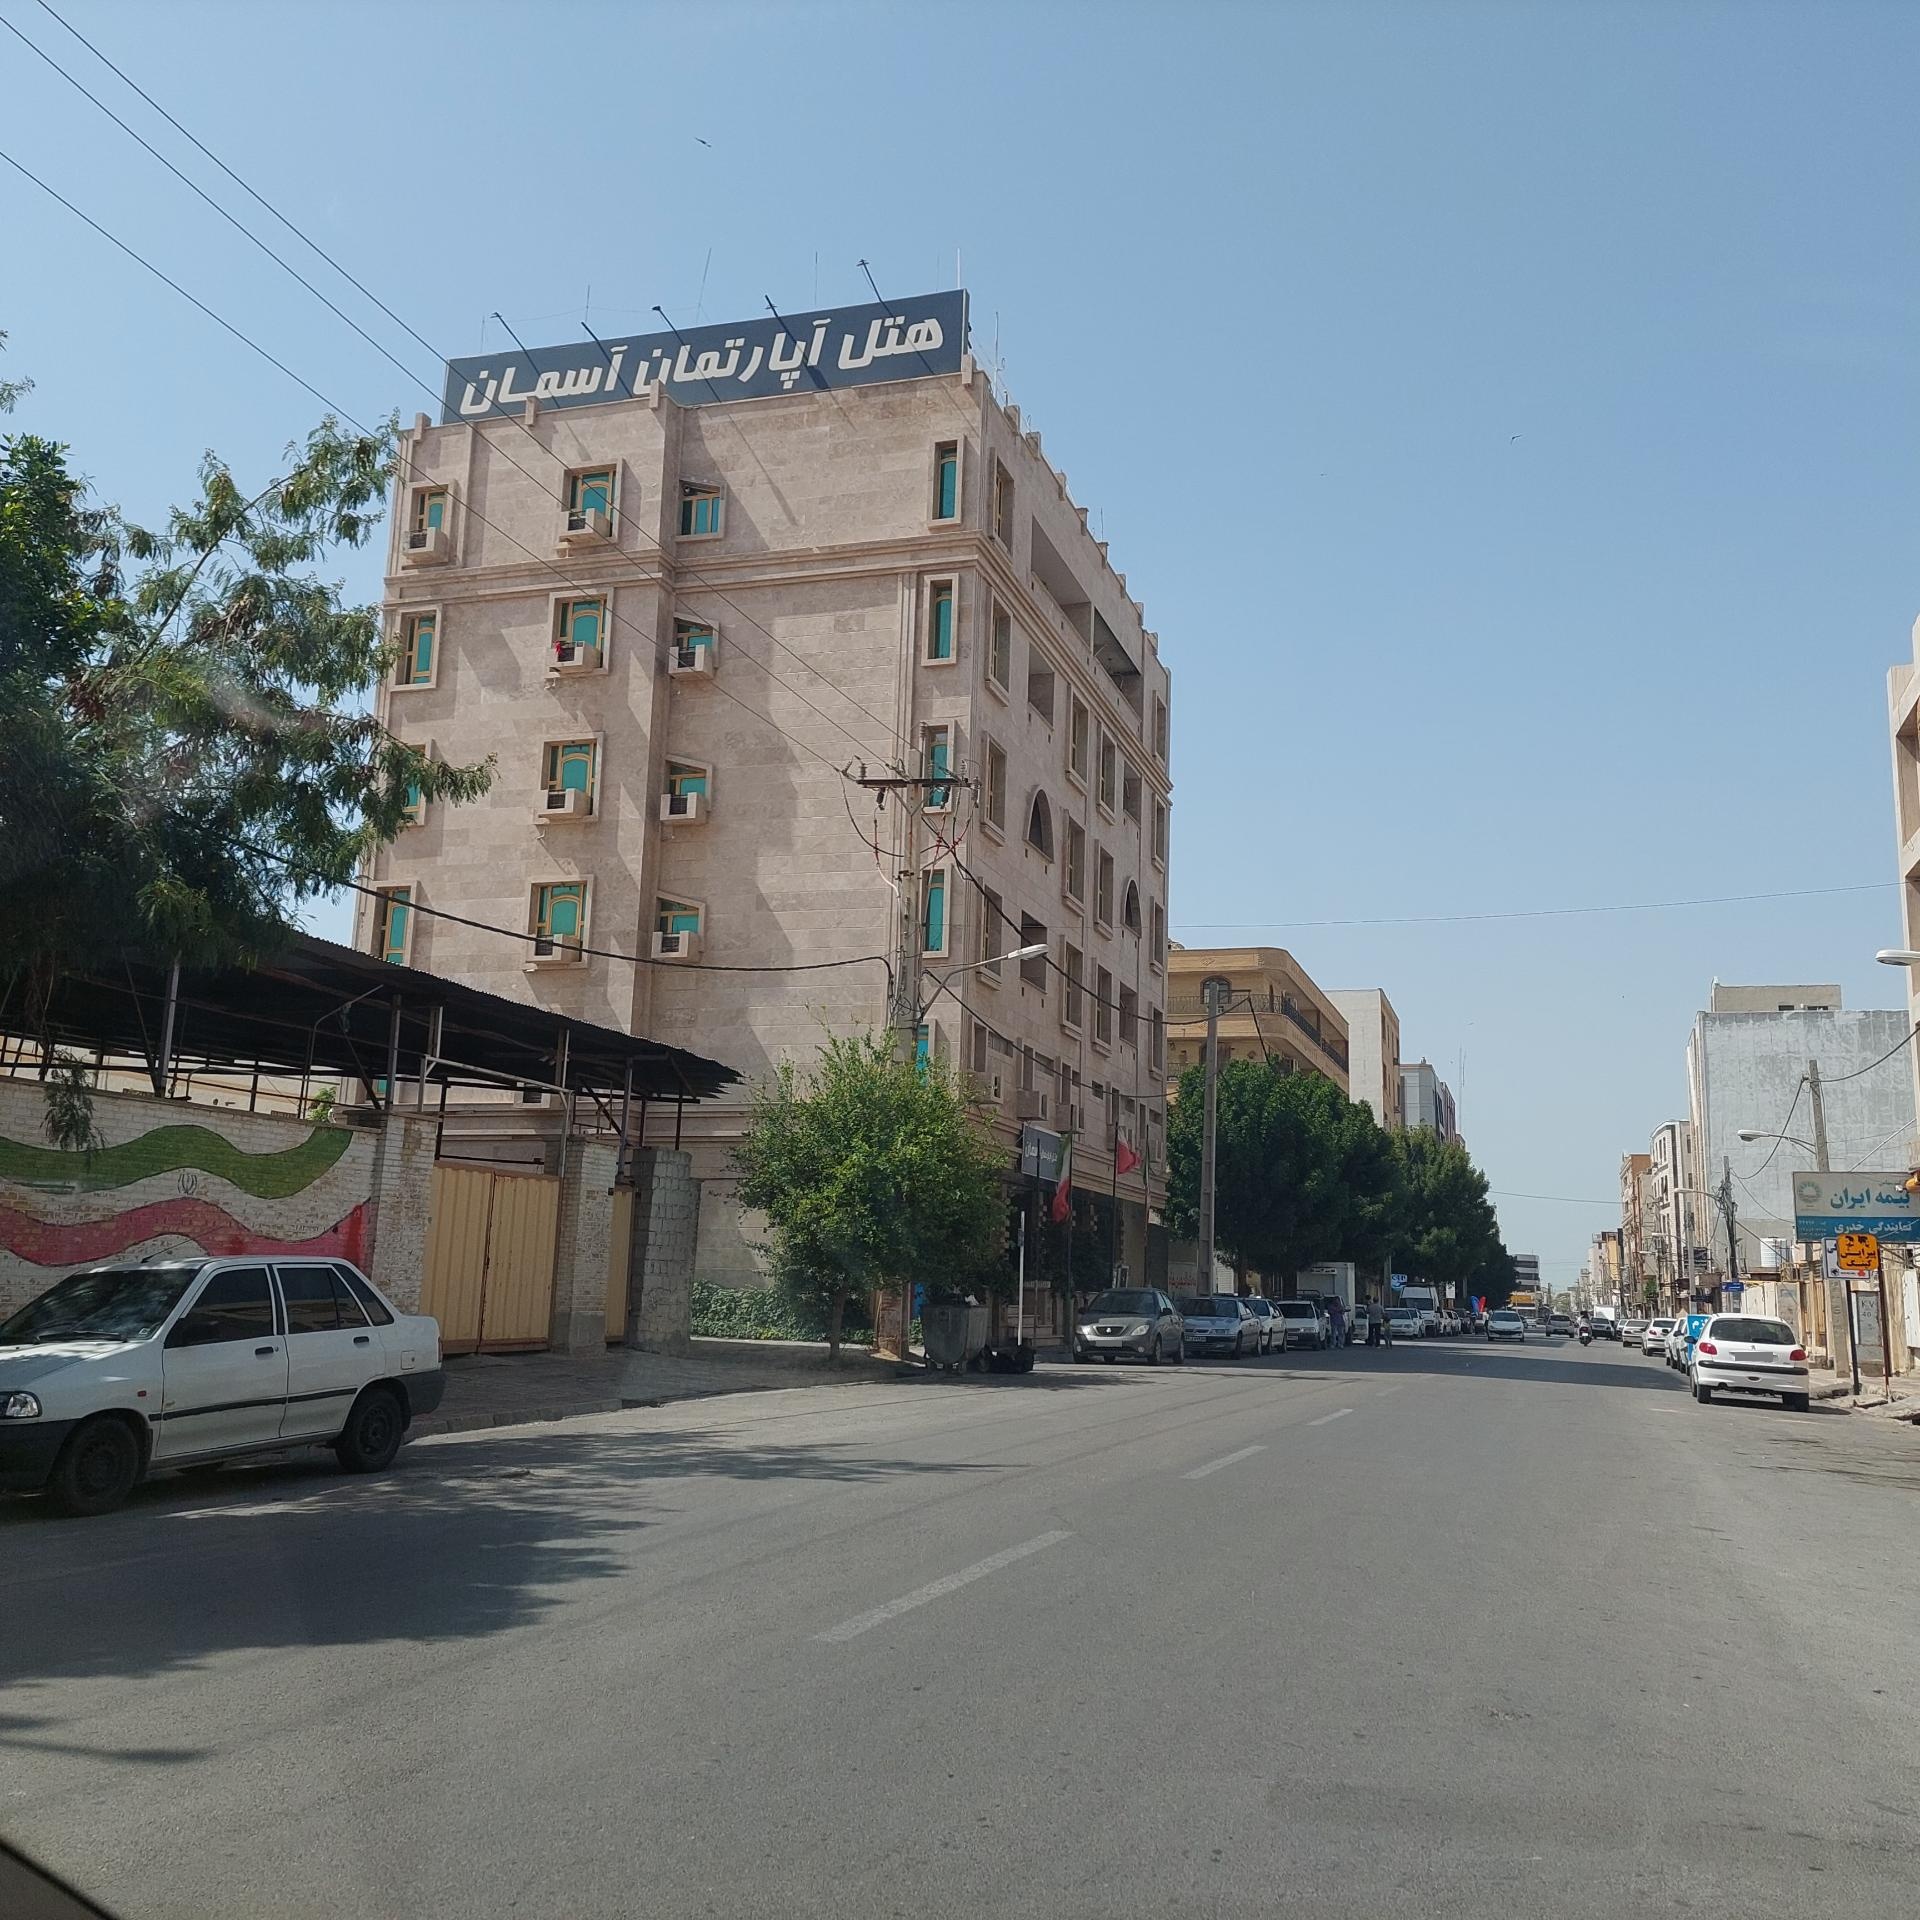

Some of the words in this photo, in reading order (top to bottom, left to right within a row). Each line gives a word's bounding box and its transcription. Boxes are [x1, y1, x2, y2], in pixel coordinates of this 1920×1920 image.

[632, 316, 834, 397] آپارتمان
[837, 313, 945, 371] هتل
[458, 343, 630, 415] آسمان
[1830, 1187, 1872, 1210] ایران
[1875, 1188, 1911, 1209] بیمه
